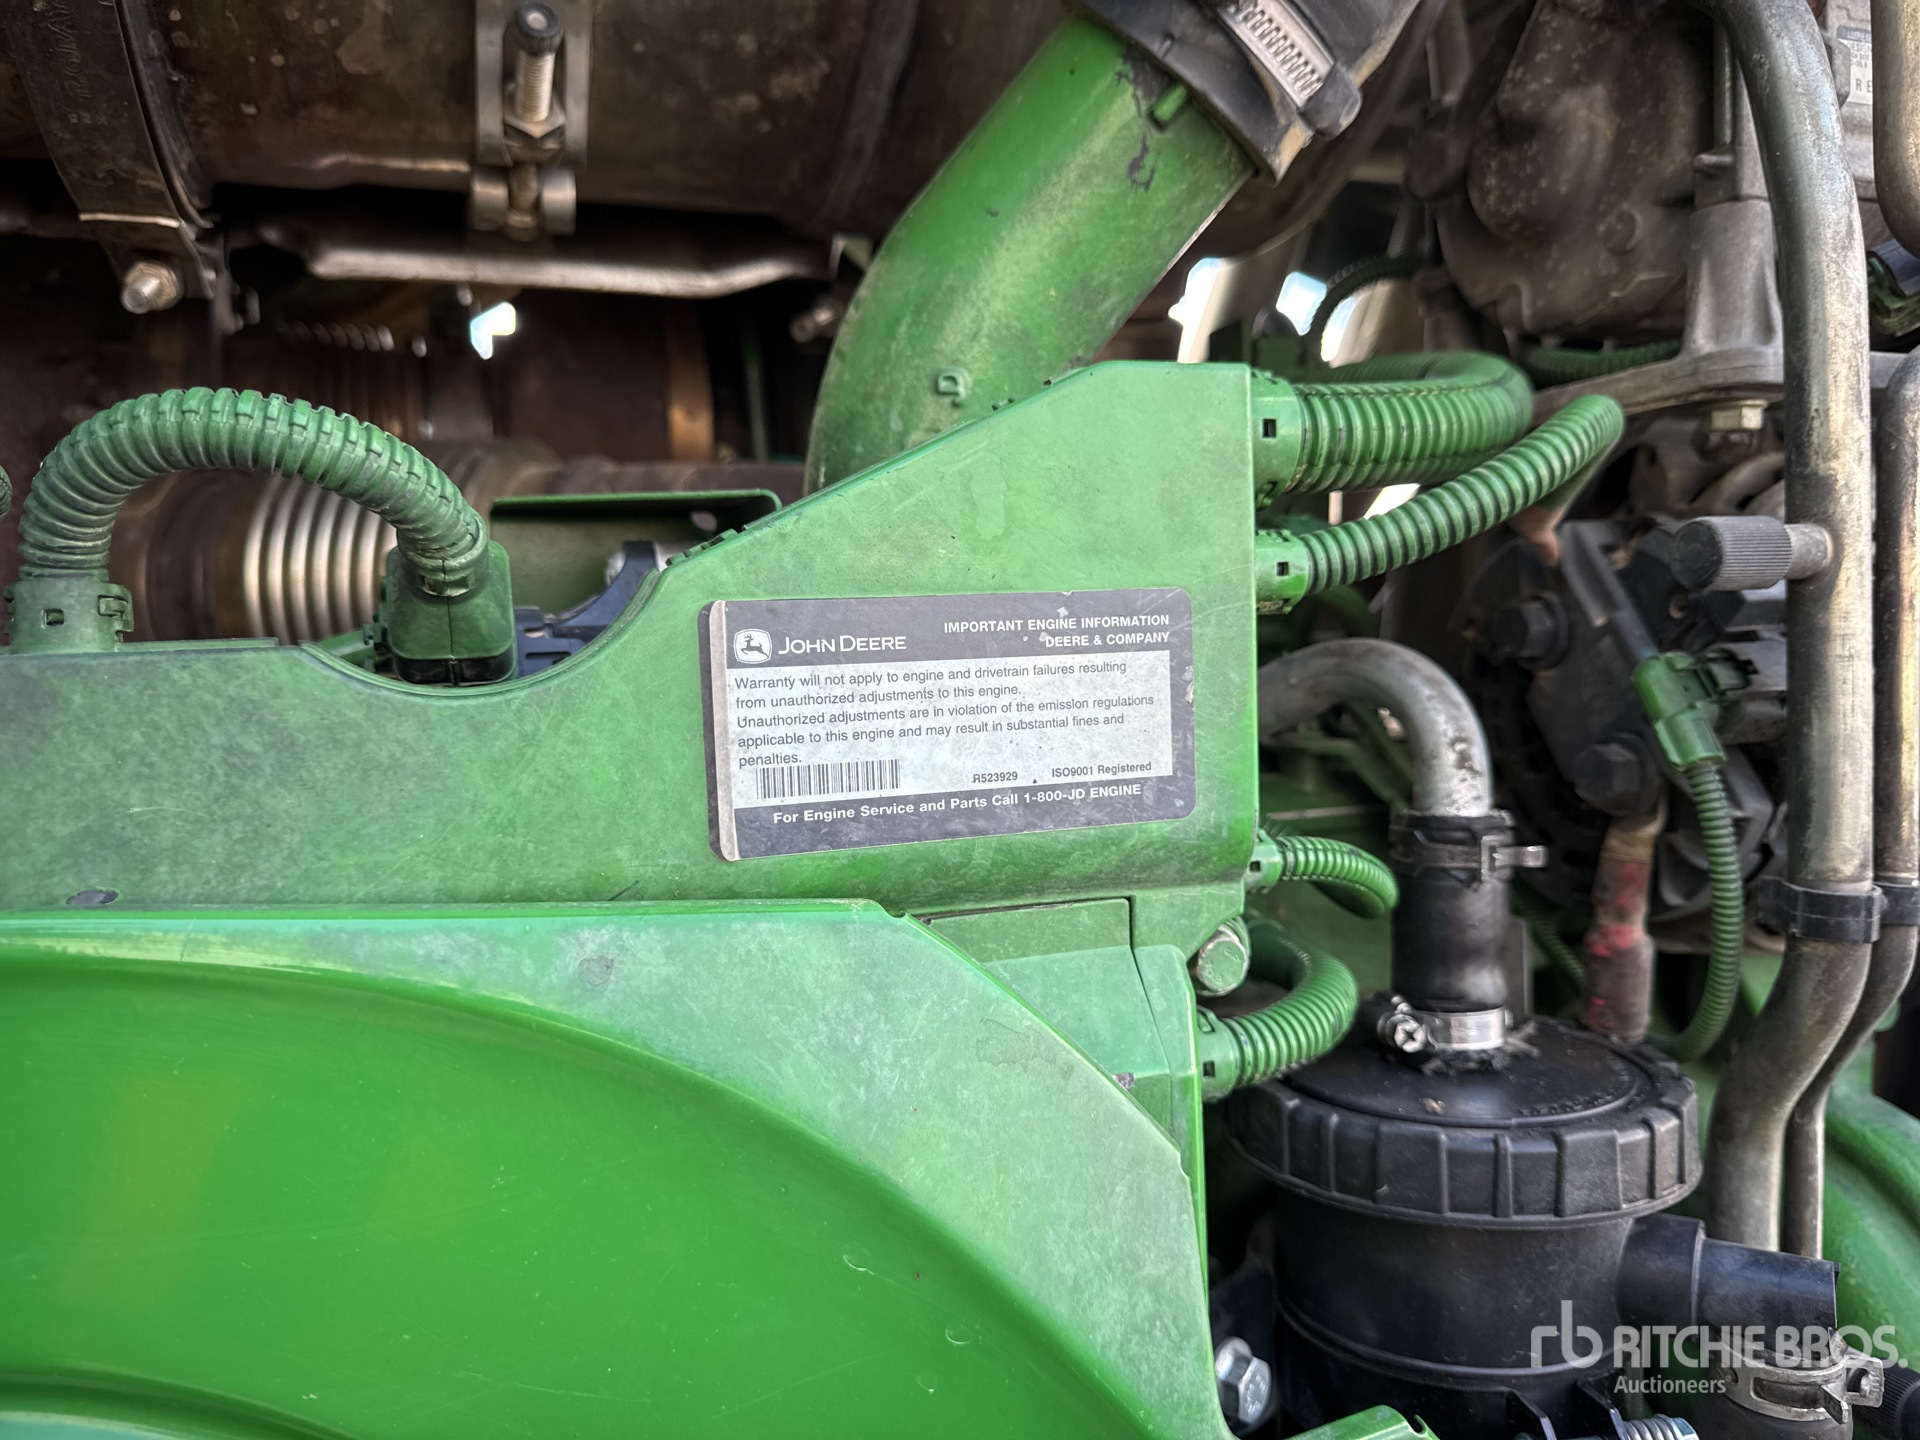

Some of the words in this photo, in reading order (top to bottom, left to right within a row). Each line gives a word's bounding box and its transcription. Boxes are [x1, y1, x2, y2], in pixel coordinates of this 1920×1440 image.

[944, 619, 1024, 633] IMPORTANT
[1027, 618, 1077, 631] ENGINE
[1081, 615, 1169, 629] INFORMATION
[778, 636, 836, 655] JOHN
[839, 635, 907, 652] DEERE
[1045, 635, 1089, 648] DEERE
[1093, 635, 1102, 646] &
[1106, 632, 1170, 645] COMPANY
[734, 676, 795, 690] Warranty
[800, 674, 820, 687] will
[824, 674, 845, 686] not
[849, 671, 883, 687] apply
[887, 672, 898, 683] to
[902, 669, 943, 685] engine
[948, 668, 971, 680] and
[974, 665, 1029, 679] drivetrain
[1033, 663, 1075, 676] failures
[1078, 661, 1127, 675] resulting
[736, 696, 766, 709] from
[770, 693, 855, 708] unauthorized
[859, 687, 934, 704] adjustments
[938, 688, 949, 699] to
[953, 685, 974, 697] this
[978, 684, 1022, 699] engine.
[737, 713, 825, 728] Unauthorized
[829, 706, 905, 723] adjustments
[909, 708, 929, 718] are
[933, 706, 944, 717] in
[948, 702, 997, 716] violation
[1001, 701, 1013, 713] of
[1016, 700, 1034, 712] the
[1038, 698, 1089, 711] emission
[1092, 695, 1154, 710] regulations
[738, 733, 805, 749] applicable
[809, 732, 821, 744] to
[825, 729, 848, 743] this
[852, 728, 895, 744] engine
[898, 726, 922, 739] and
[925, 726, 952, 739] may
[955, 722, 988, 735] result
[992, 720, 1003, 732] in
[1006, 717, 1069, 731] substantial
[1072, 715, 1099, 727] fines
[1103, 713, 1125, 725] and
[739, 753, 802, 770] penalties.
[1051, 766, 1093, 778] ISO9001
[1097, 762, 1152, 776] Registered
[973, 771, 1018, 784] R523929
[773, 811, 799, 824] For
[803, 807, 856, 824] Engine
[860, 803, 914, 817] Service
[919, 799, 945, 812] and
[950, 797, 987, 810] Parts
[991, 793, 1018, 806] Call
[1024, 788, 1086, 803] 1-800-JD
[1090, 784, 1142, 798] ENGINE
